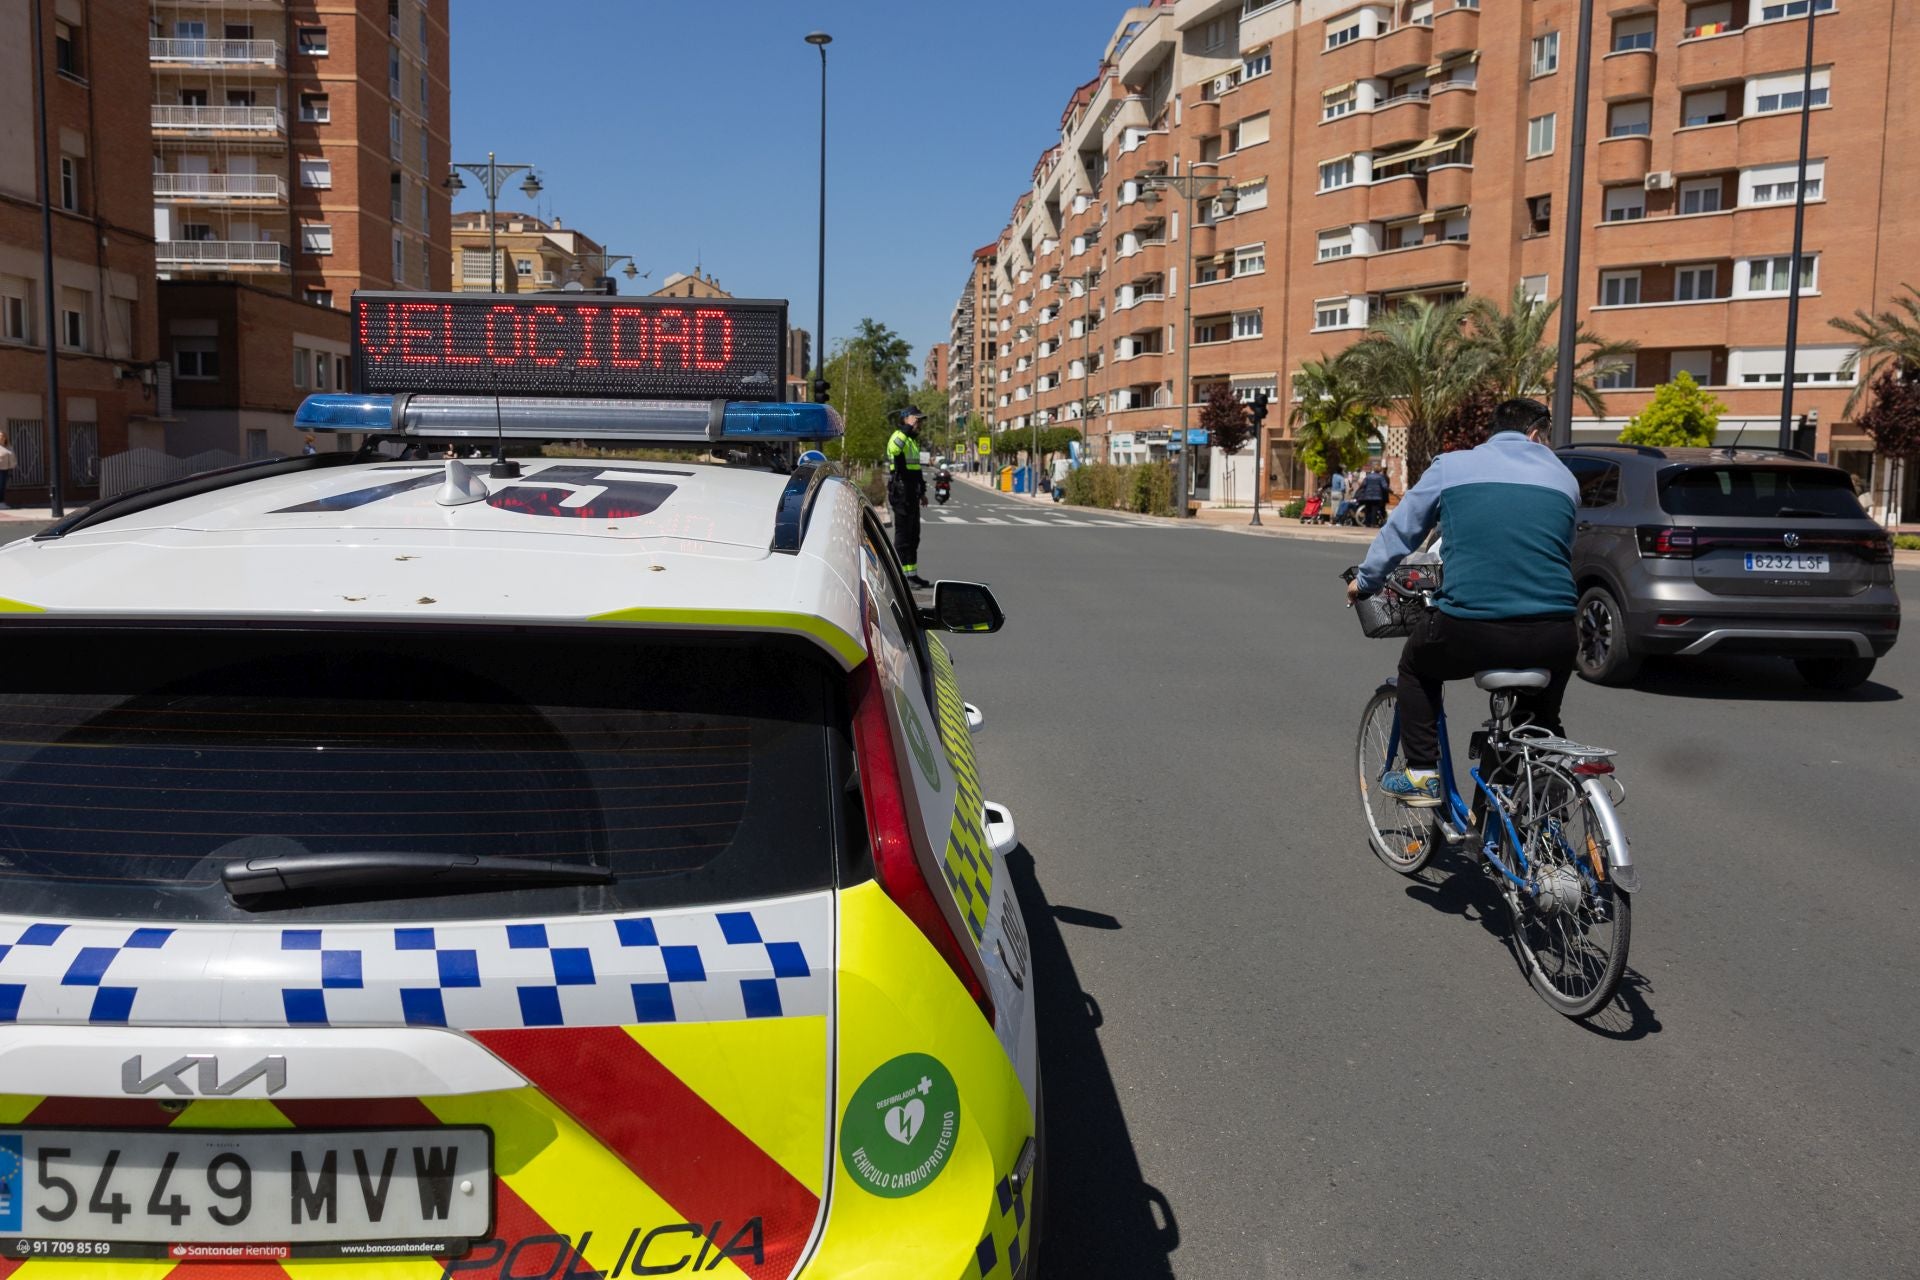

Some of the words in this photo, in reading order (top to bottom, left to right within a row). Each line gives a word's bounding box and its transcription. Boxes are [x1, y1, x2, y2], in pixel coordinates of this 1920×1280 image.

[360, 303, 732, 370] VELOCIDAD
[1755, 554, 1793, 569] 6232
[1797, 555, 1824, 570] LSF
[121, 1053, 287, 1096] KIA
[876, 1087, 917, 1110] DESFIBRILADOR
[851, 1146, 890, 1189] VEHICULO
[891, 1110, 954, 1189] CARDIOPROTEGIDO
[36, 1146, 254, 1227] 5449
[290, 1145, 459, 1224] MVW
[33, 1241, 48, 1253] 91
[51, 1241, 75, 1254] 709
[76, 1242, 92, 1254] 85
[94, 1242, 111, 1255] 69
[187, 1245, 244, 1256] Santander
[245, 1245, 288, 1258] Renting
[341, 1242, 446, 1254] www.bancosantander.es
[440, 1216, 766, 1280] POLICIA
